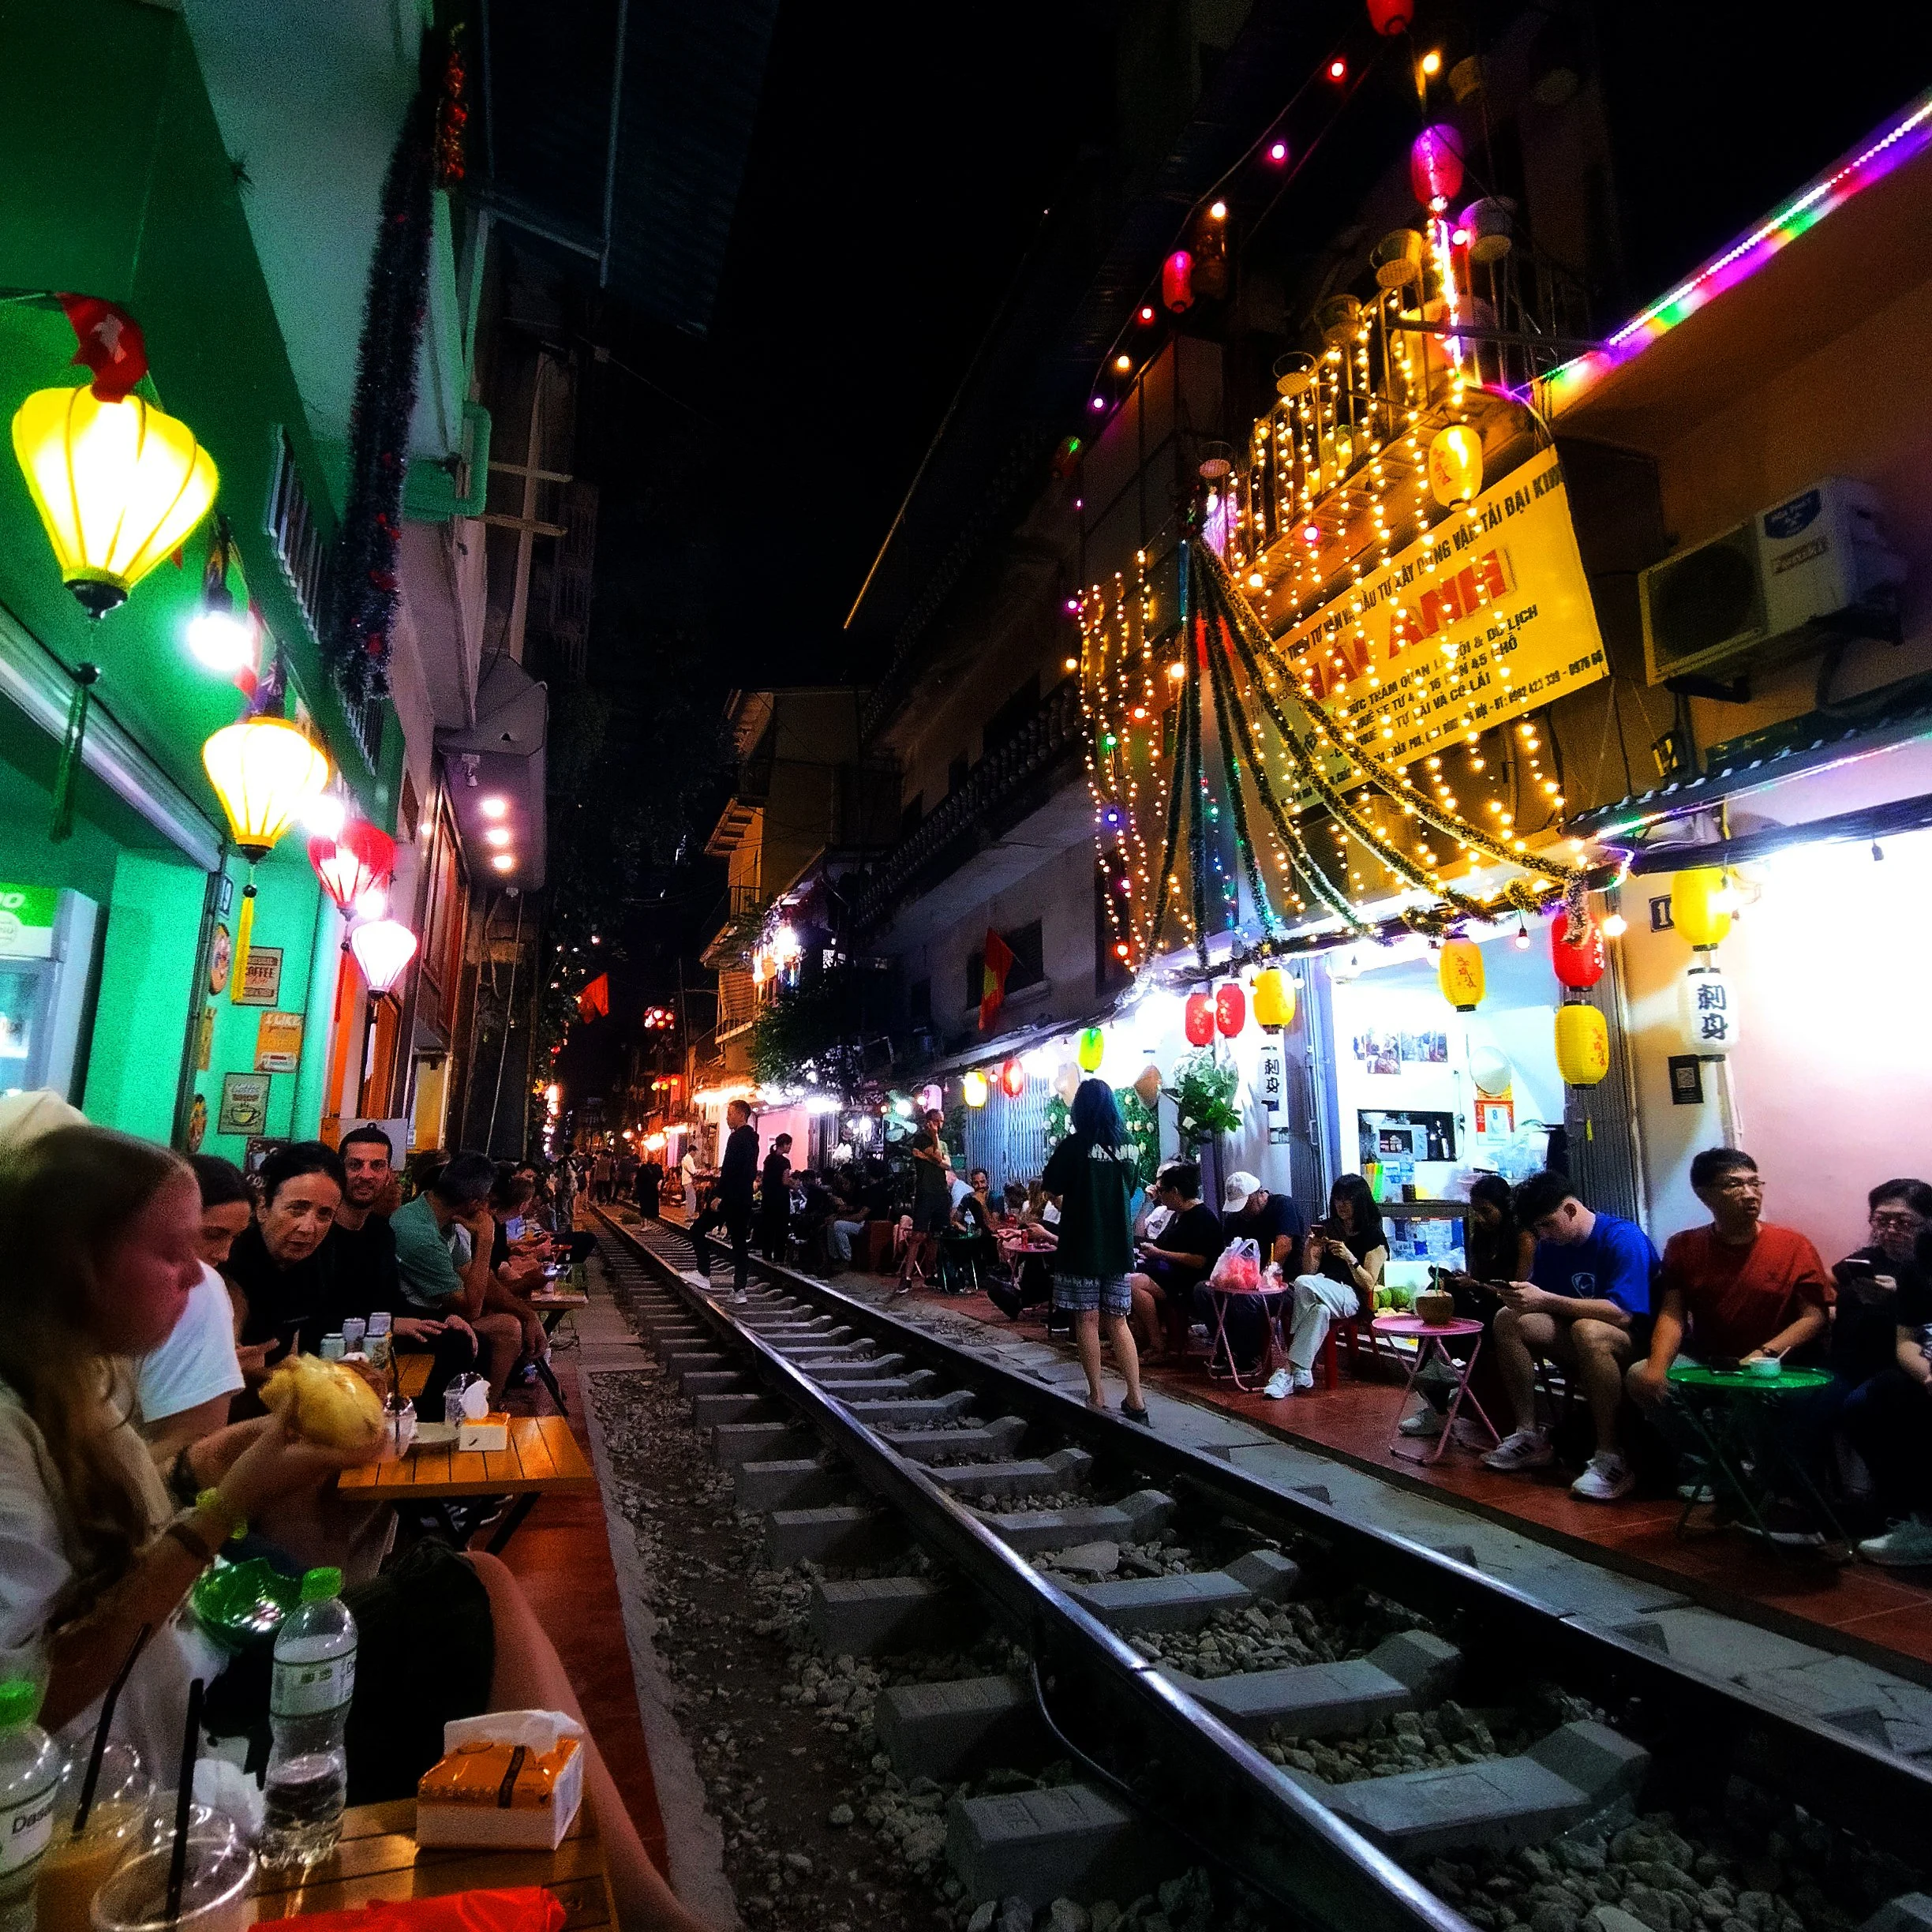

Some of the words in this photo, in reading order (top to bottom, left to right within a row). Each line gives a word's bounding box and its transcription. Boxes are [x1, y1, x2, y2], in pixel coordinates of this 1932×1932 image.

[1480, 501, 1503, 533] TẢI
[1504, 484, 1530, 518] ĐẠI
[1389, 549, 1506, 659] ANH
[1507, 604, 1538, 631] LỊCH
